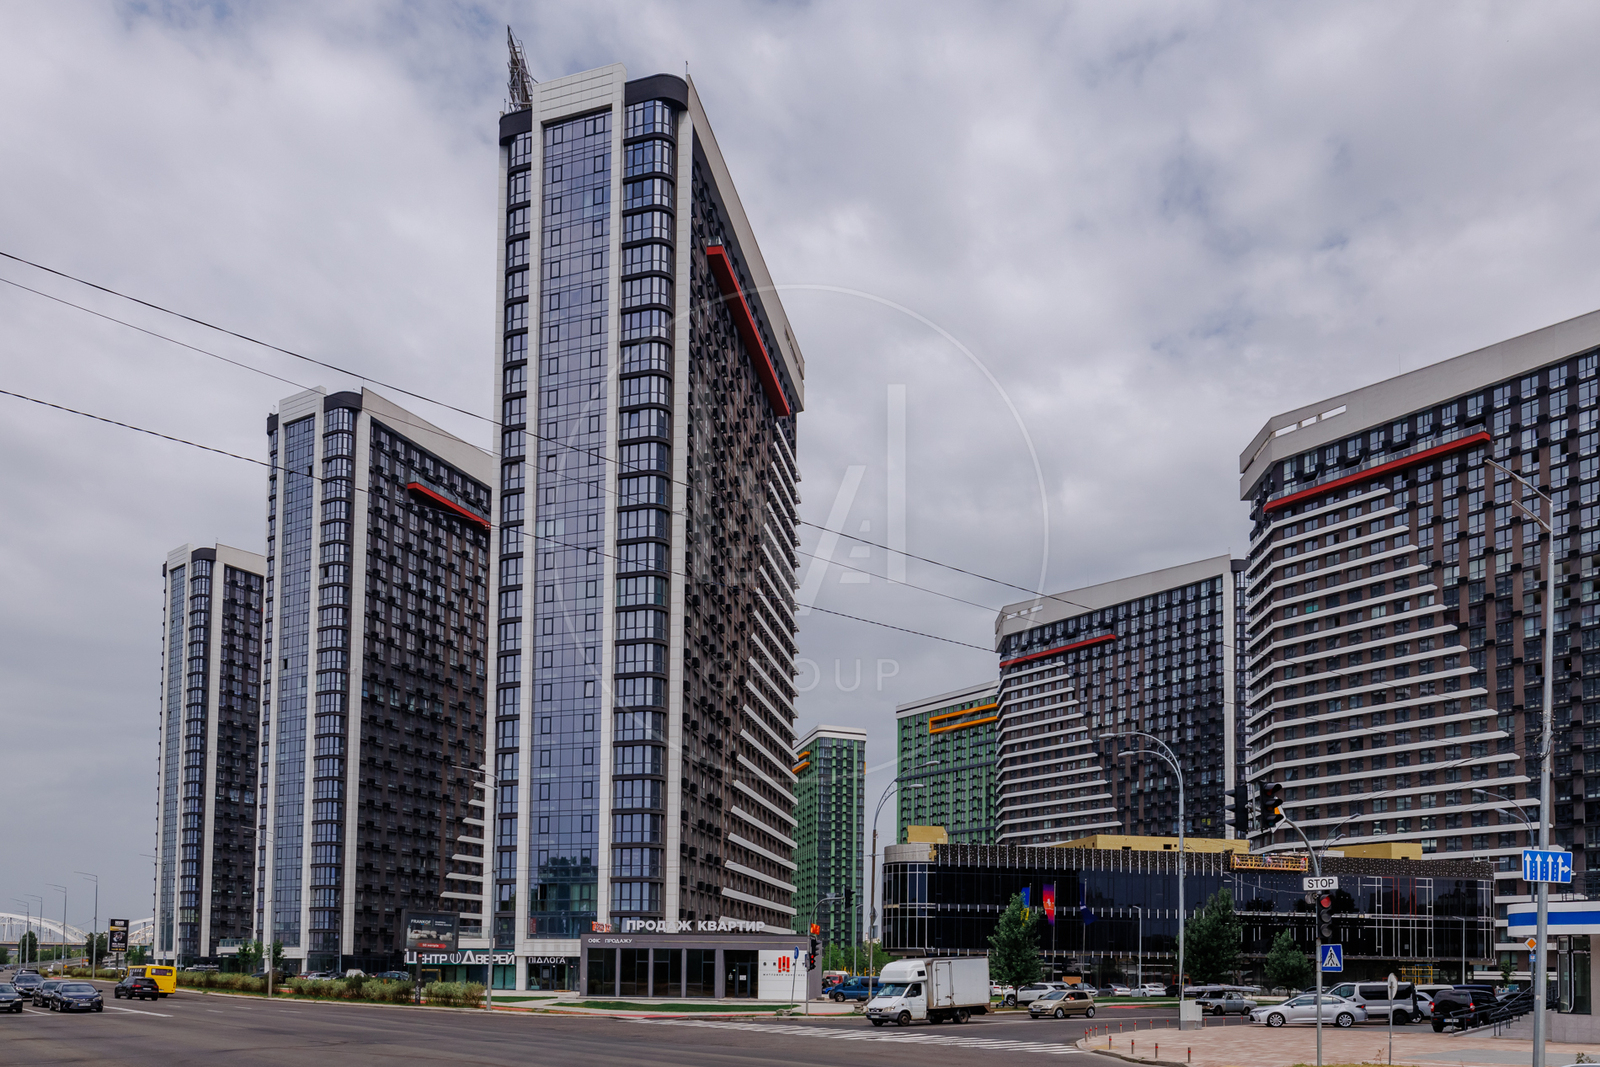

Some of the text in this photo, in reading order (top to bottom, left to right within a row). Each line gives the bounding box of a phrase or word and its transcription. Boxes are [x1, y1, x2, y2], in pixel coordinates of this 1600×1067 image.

[1307, 879, 1334, 888] STOP
[626, 919, 693, 932] ПРОДАЖ
[698, 920, 766, 932] КВАРТИР
